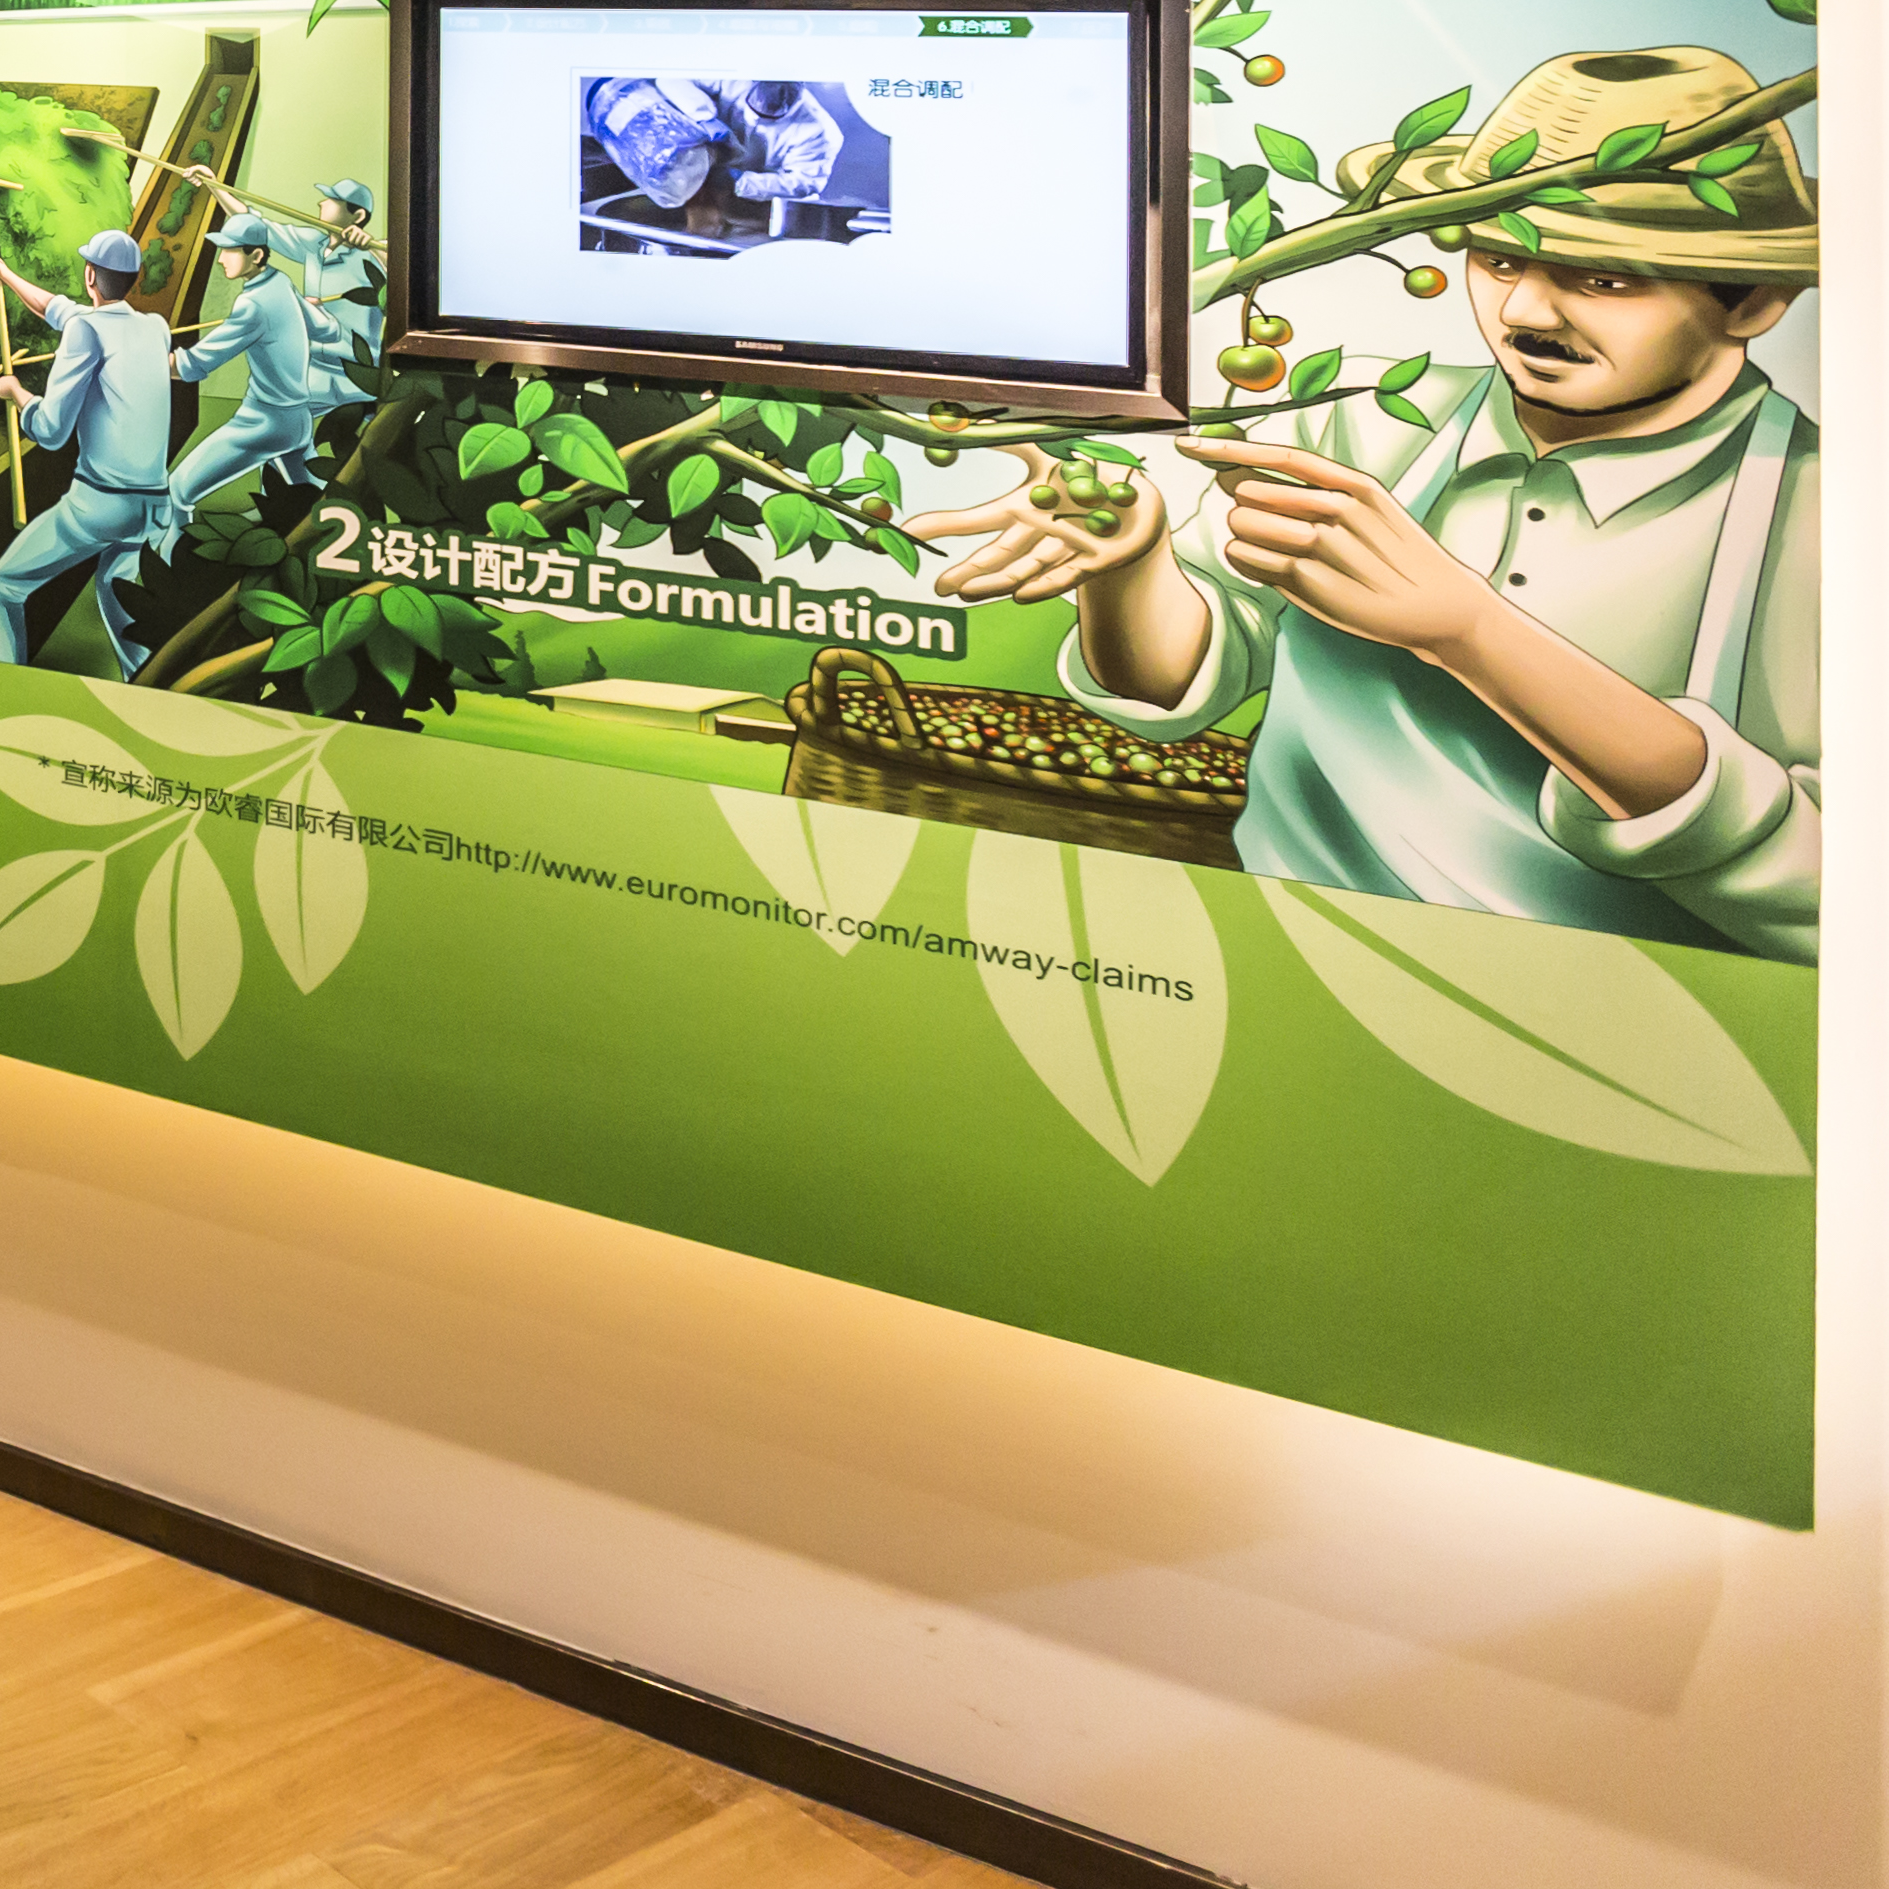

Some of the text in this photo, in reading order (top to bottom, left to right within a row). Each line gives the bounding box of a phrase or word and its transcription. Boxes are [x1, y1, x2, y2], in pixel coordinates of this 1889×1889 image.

[868, 78, 964, 99] 混合调配
[368, 527, 582, 600] 设计配方
[587, 563, 956, 652] Formulation
